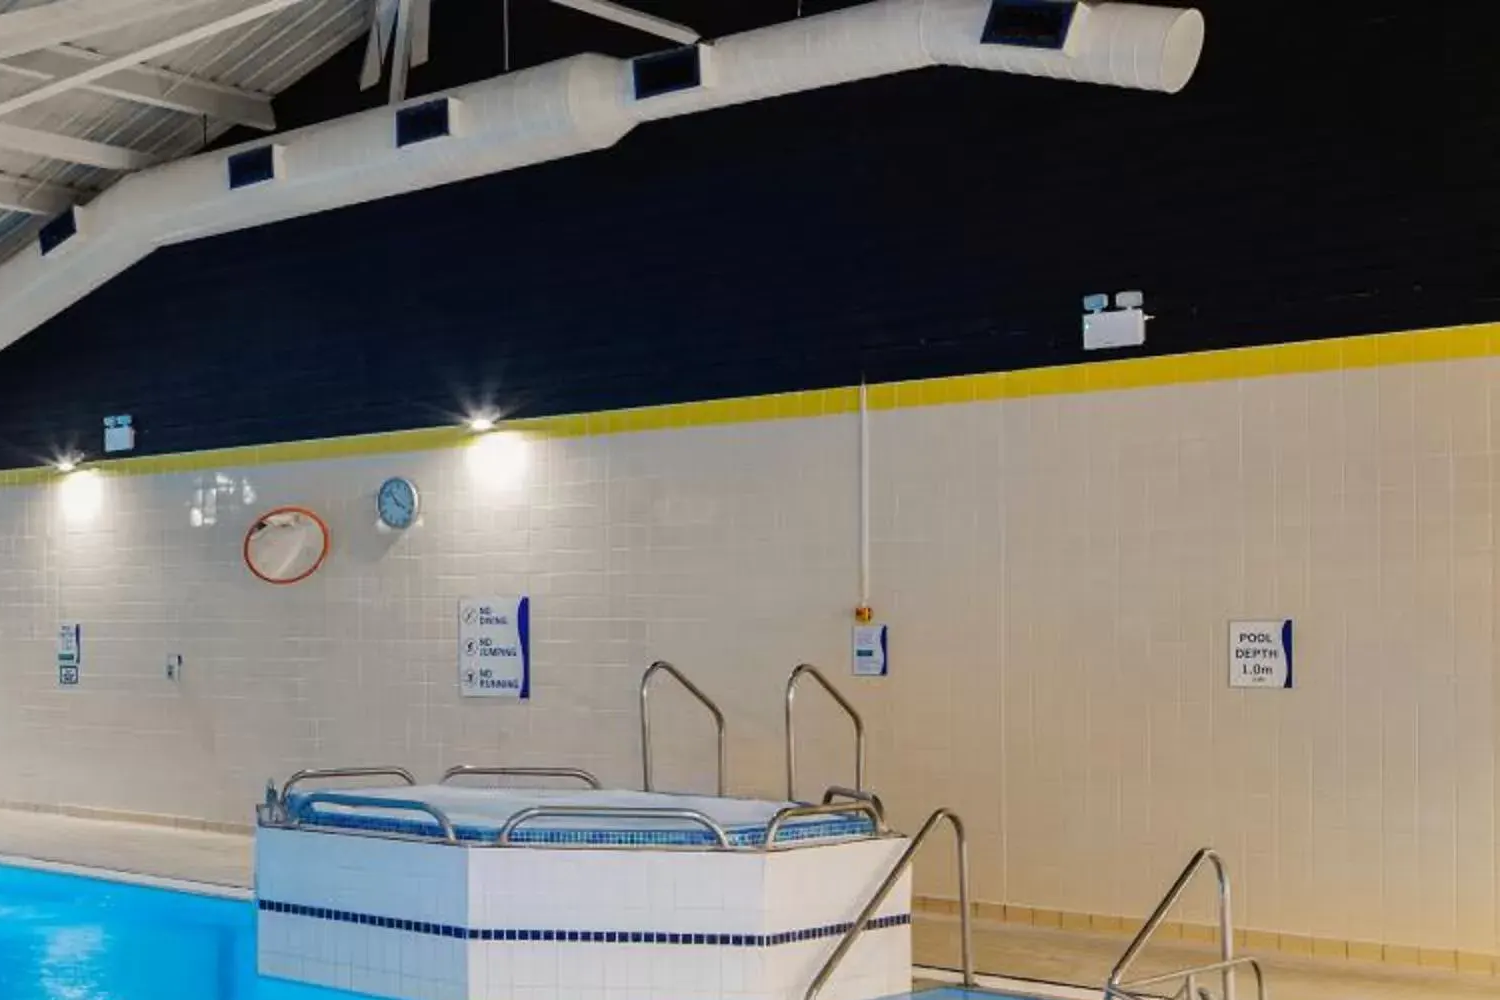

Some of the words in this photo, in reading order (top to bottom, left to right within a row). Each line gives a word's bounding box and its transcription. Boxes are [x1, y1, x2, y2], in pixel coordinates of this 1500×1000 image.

[479, 638, 492, 647] NO
[1239, 633, 1273, 643] POOL
[1235, 649, 1278, 659] DEPTH
[479, 668, 492, 678] NO
[1242, 663, 1273, 675] 1.0m
